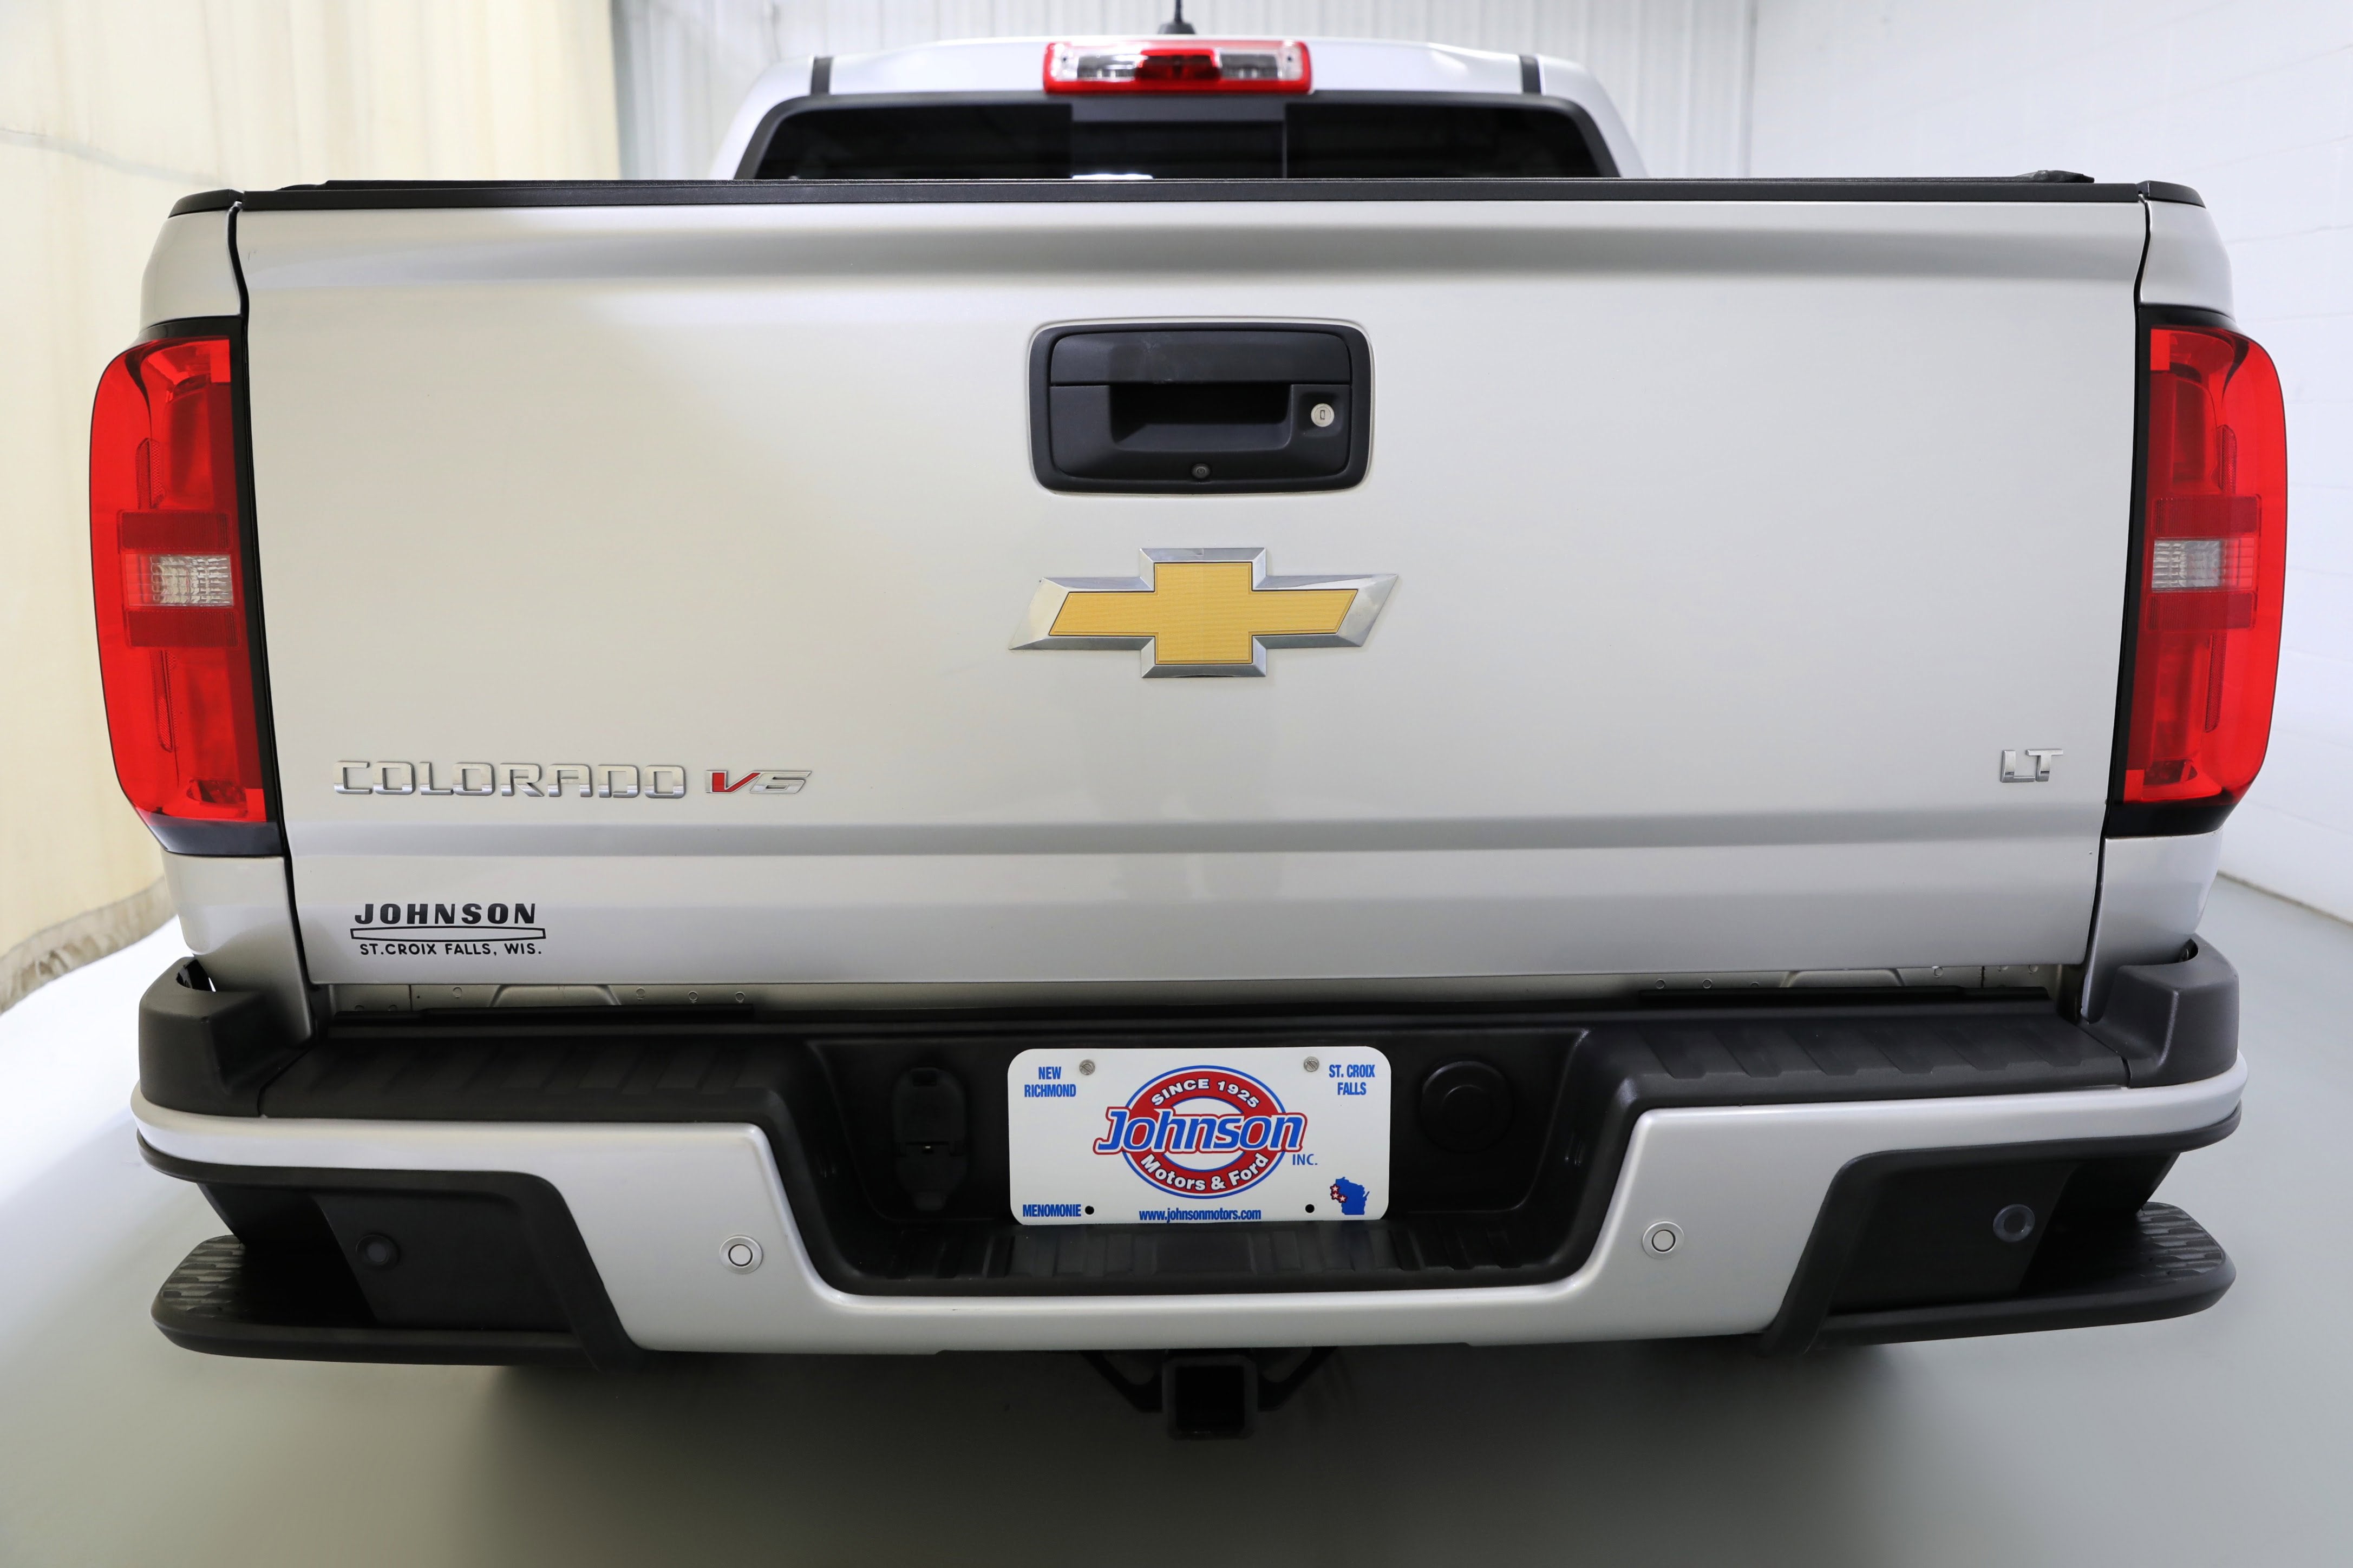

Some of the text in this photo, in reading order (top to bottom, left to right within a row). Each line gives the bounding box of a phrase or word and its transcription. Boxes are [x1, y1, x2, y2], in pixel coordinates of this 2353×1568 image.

[2000, 748, 2064, 783] LT
[334, 760, 811, 799] COLORADO V6
[354, 903, 536, 924] JOHNSON
[445, 943, 497, 956] FALLS,
[504, 943, 542, 955] WIS.
[1038, 1066, 1062, 1080] NEW
[1329, 1064, 1376, 1078] ST. CROIX
[1024, 1084, 1076, 1098] RICHMOND
[1151, 1078, 1259, 1108] SINCE 1925
[1337, 1082, 1367, 1095] FALLS
[1097, 1110, 1303, 1151] Johnson
[1292, 1153, 1318, 1166] INC.
[1139, 1152, 1270, 1191] Motors & Ford
[1022, 1204, 1082, 1217] MENOMONIE
[1139, 1208, 1262, 1223] www.johnsonmotors.com
